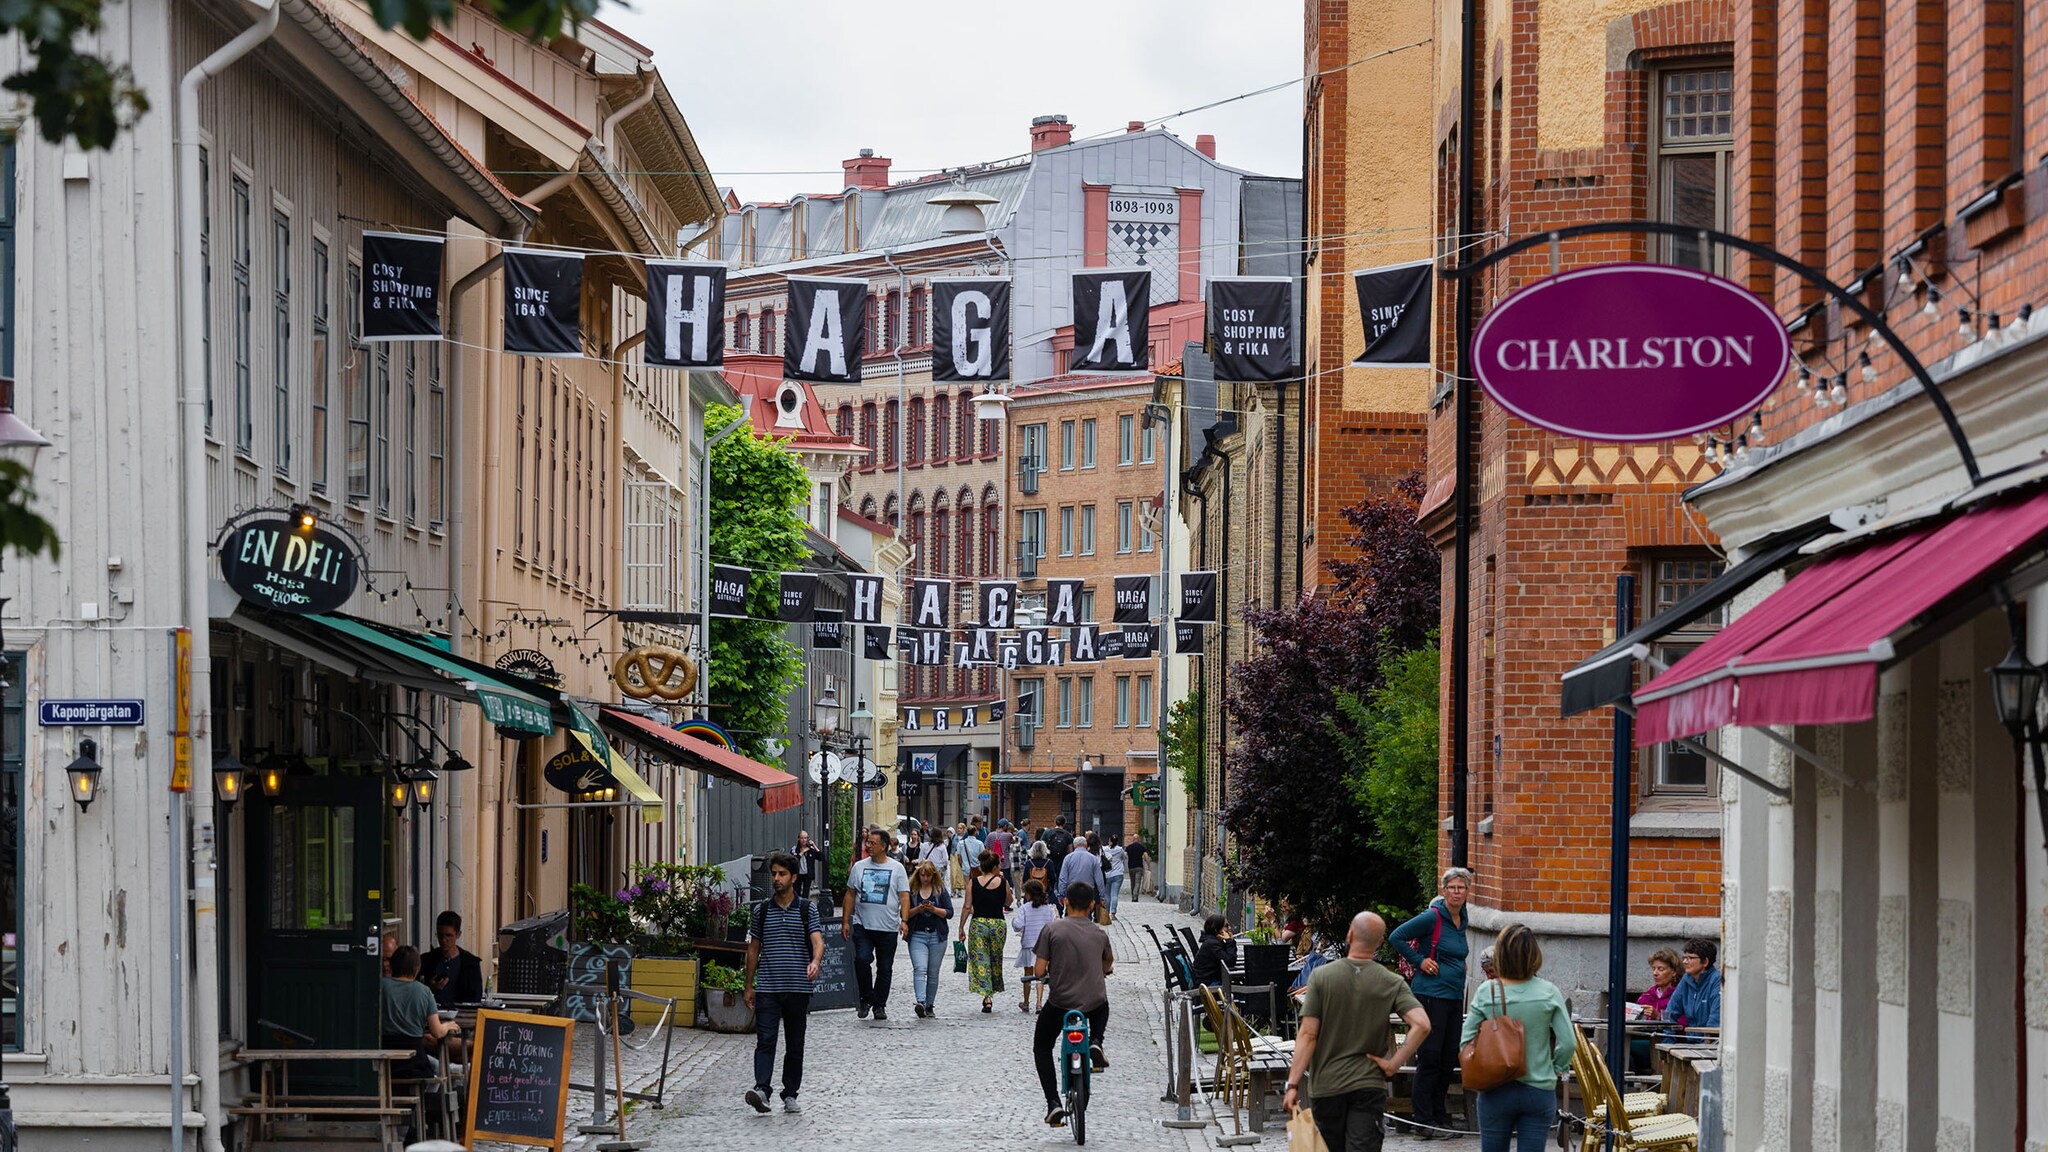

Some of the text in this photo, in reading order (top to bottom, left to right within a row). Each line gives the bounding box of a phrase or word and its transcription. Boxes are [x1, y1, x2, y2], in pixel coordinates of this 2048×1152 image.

[1109, 200, 1174, 215] 1893-1993
[373, 263, 404, 279] COSY
[372, 280, 432, 299] SHOPPING
[514, 286, 549, 303] SINCE
[373, 298, 382, 309] &
[514, 302, 546, 317] 1648
[1223, 309, 1255, 322] COSY
[1223, 325, 1286, 339] SHOPPING
[1223, 342, 1270, 356] & FIKA
[1496, 336, 1754, 371] CHARLSTON
[240, 529, 279, 568] EN
[266, 571, 305, 589] Haga
[714, 580, 744, 597] HAGA
[783, 591, 803, 599] SINCE
[272, 590, 291, 605] EKO
[1117, 590, 1147, 603] HAGA
[815, 621, 839, 634] HAGA
[1125, 632, 1149, 643] HAGA
[495, 650, 551, 671] BRÄUTIGAM
[52, 704, 132, 721] Kaponjärgatan
[498, 1025, 534, 1042] IF YOU
[494, 1041, 554, 1058] ARE LOOKING
[488, 1055, 505, 1070] FOR
[508, 1058, 517, 1071] A
[499, 1073, 513, 1084] eat
[487, 1087, 510, 1101] THIS
[512, 1090, 520, 1101] IS
